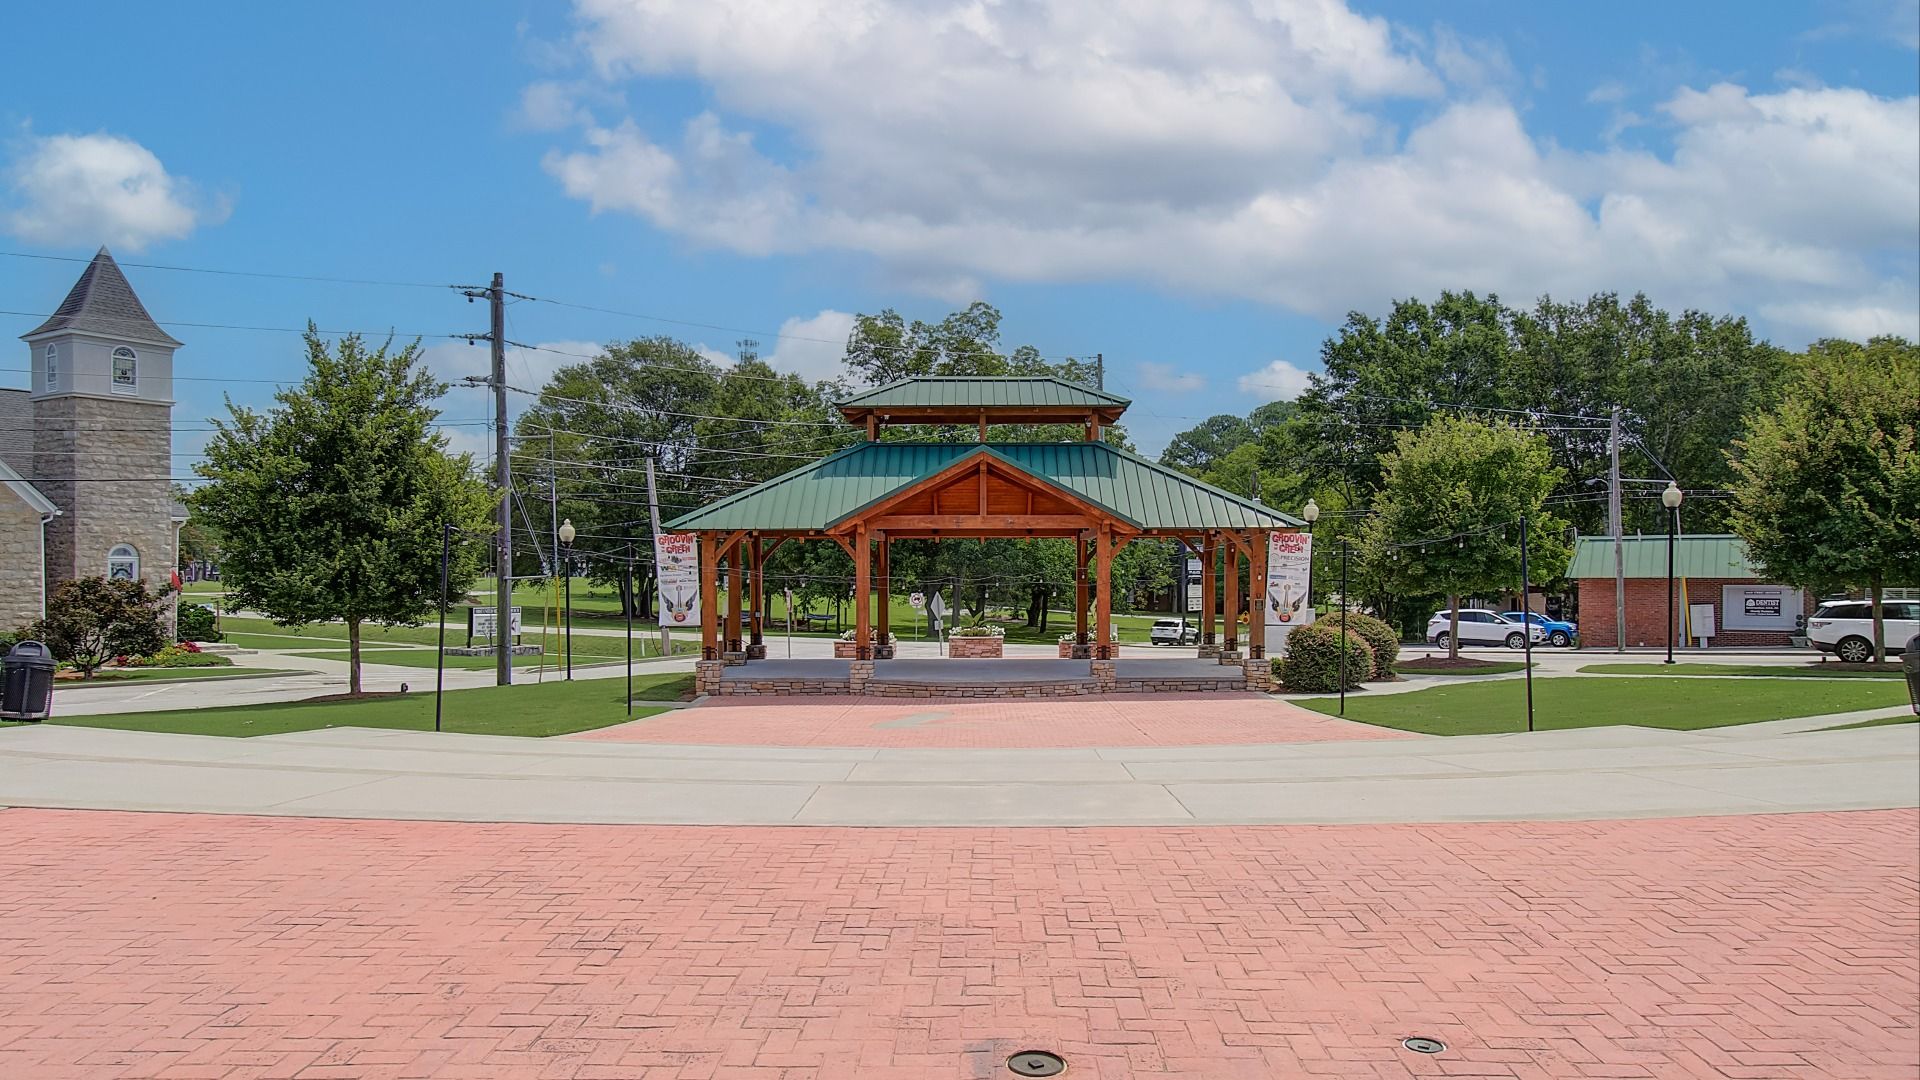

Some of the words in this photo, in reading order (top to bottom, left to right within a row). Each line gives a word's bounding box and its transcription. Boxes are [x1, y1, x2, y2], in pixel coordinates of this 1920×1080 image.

[658, 534, 695, 545] GROOVIN'
[1272, 533, 1310, 545] GROOVIN'
[666, 544, 691, 554] GREEN
[1279, 543, 1304, 554] GREEN
